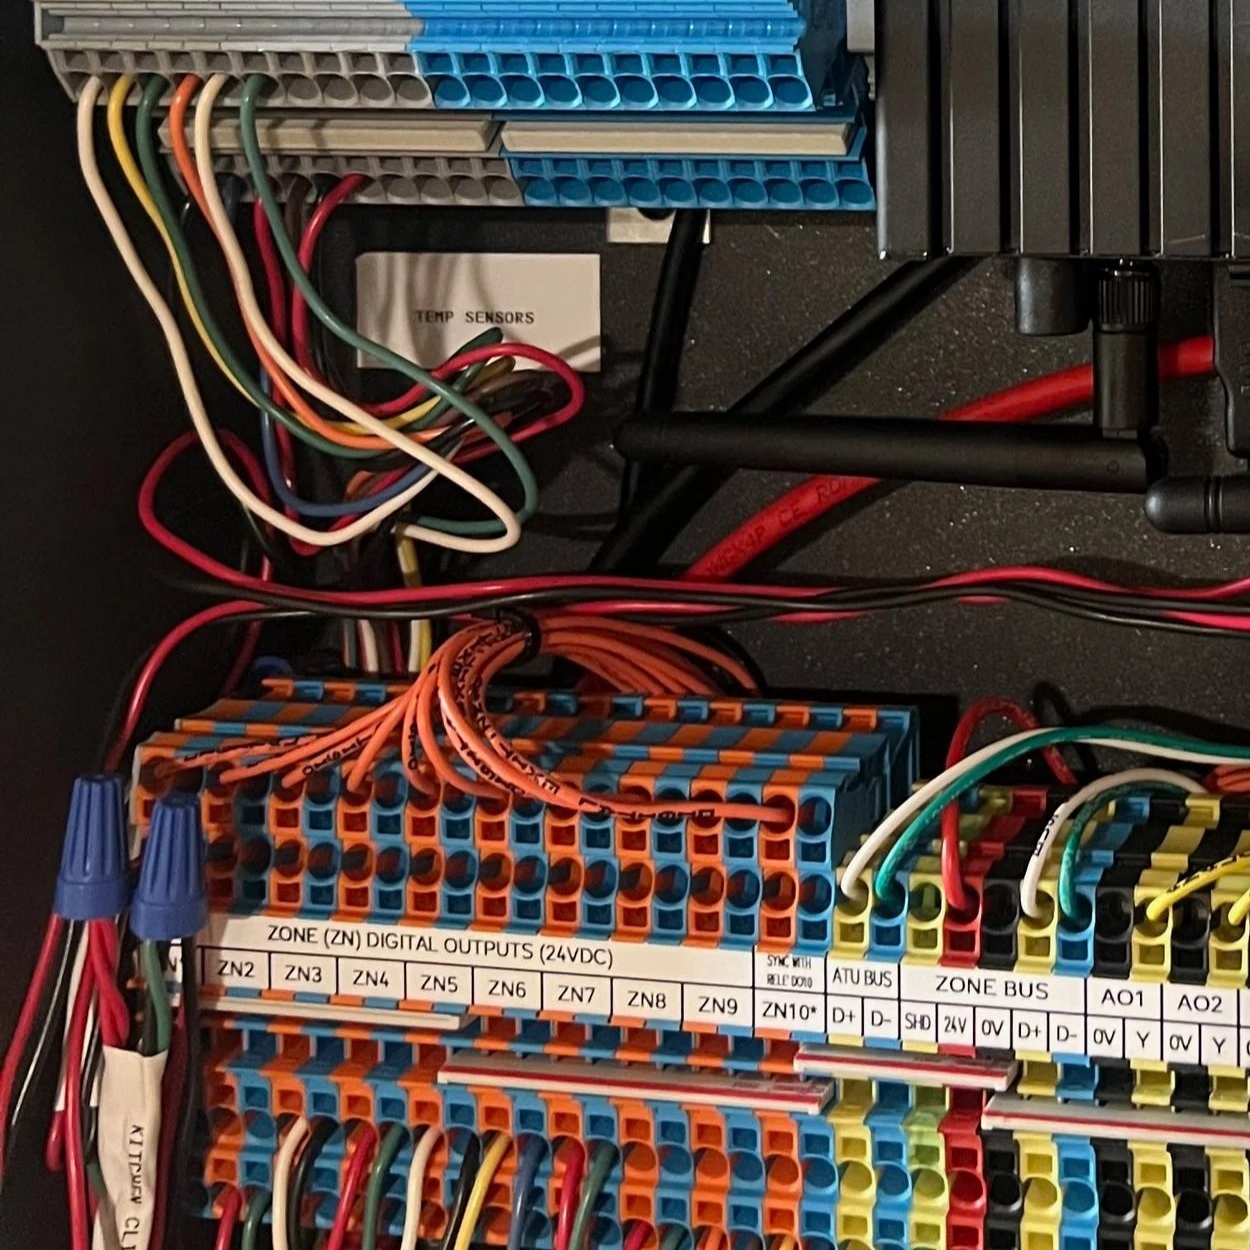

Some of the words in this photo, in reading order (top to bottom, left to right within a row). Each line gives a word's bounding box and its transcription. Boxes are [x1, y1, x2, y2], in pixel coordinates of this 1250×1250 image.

[415, 310, 453, 324] TEMP
[465, 310, 535, 324] SENSORS
[267, 924, 318, 943] ZONE
[323, 928, 361, 951] (ZN)
[366, 932, 439, 953] DIGITAL
[443, 937, 533, 959] OUTPUTS
[539, 944, 614, 970] (24VDC)
[217, 959, 256, 978] ZN2
[767, 954, 789, 968] SYNC
[285, 964, 322, 983] ZN3
[352, 969, 390, 987] ZN4
[832, 968, 861, 985] ATU
[864, 971, 892, 988] BUS
[420, 974, 459, 993] ZN5
[488, 980, 526, 998] ZN6
[935, 975, 997, 996] ZONE
[1003, 979, 1049, 999] BUS
[557, 985, 596, 1003] ZN7
[627, 991, 667, 1009] ZN8
[1101, 989, 1144, 1008] AO1
[698, 996, 738, 1015] ZN9
[1177, 995, 1223, 1013] AO2
[832, 1007, 856, 1023] D+
[871, 1010, 892, 1027] D-
[904, 1012, 931, 1030] SHD
[944, 1017, 967, 1035] 24V
[981, 1020, 1004, 1036] 0V
[1018, 1021, 1042, 1038] D+
[1056, 1025, 1078, 1042] D-
[1093, 1028, 1116, 1045] 0V
[1136, 1031, 1149, 1048] Y
[1169, 1034, 1193, 1051] 0V
[1213, 1037, 1226, 1054] Y
